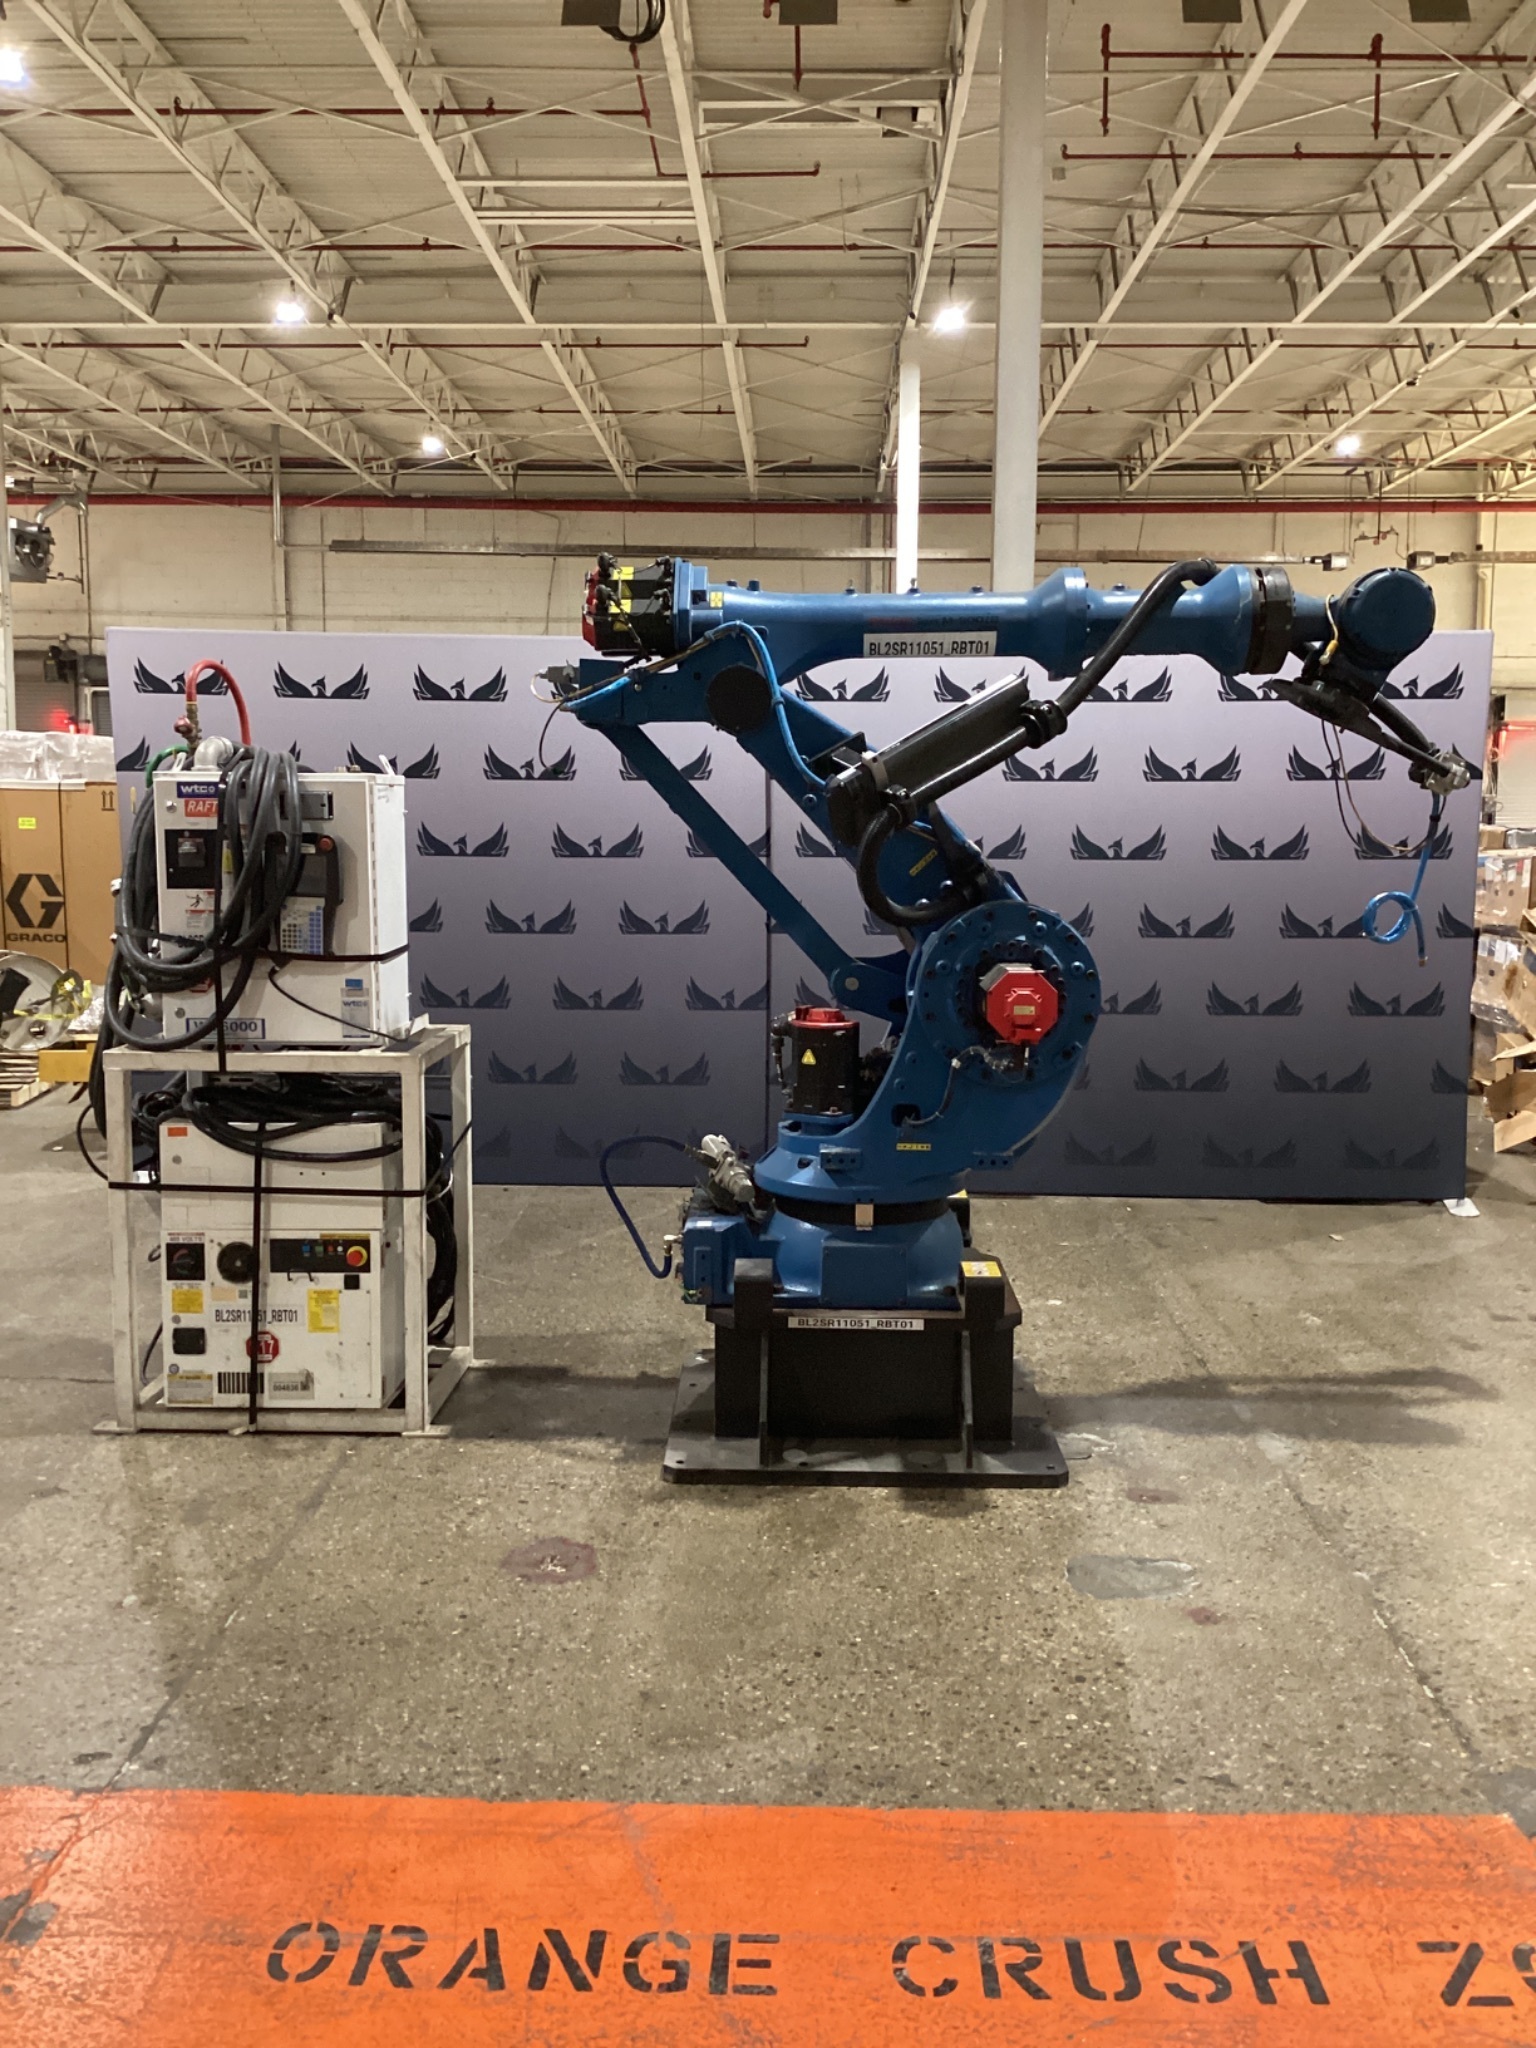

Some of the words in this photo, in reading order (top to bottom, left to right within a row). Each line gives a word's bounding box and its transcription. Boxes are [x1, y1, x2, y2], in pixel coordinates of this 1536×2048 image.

[869, 641, 989, 656] BL2SR11051_RBT01
[187, 801, 218, 812] RAFT
[7, 933, 66, 943] GRACO
[215, 1309, 298, 1324] BL2SR1151_RBT01
[797, 1318, 914, 1329] BL2SR11051_RBT01
[266, 1921, 780, 1996] ORANGE
[891, 1935, 1331, 2005] CRUSH
